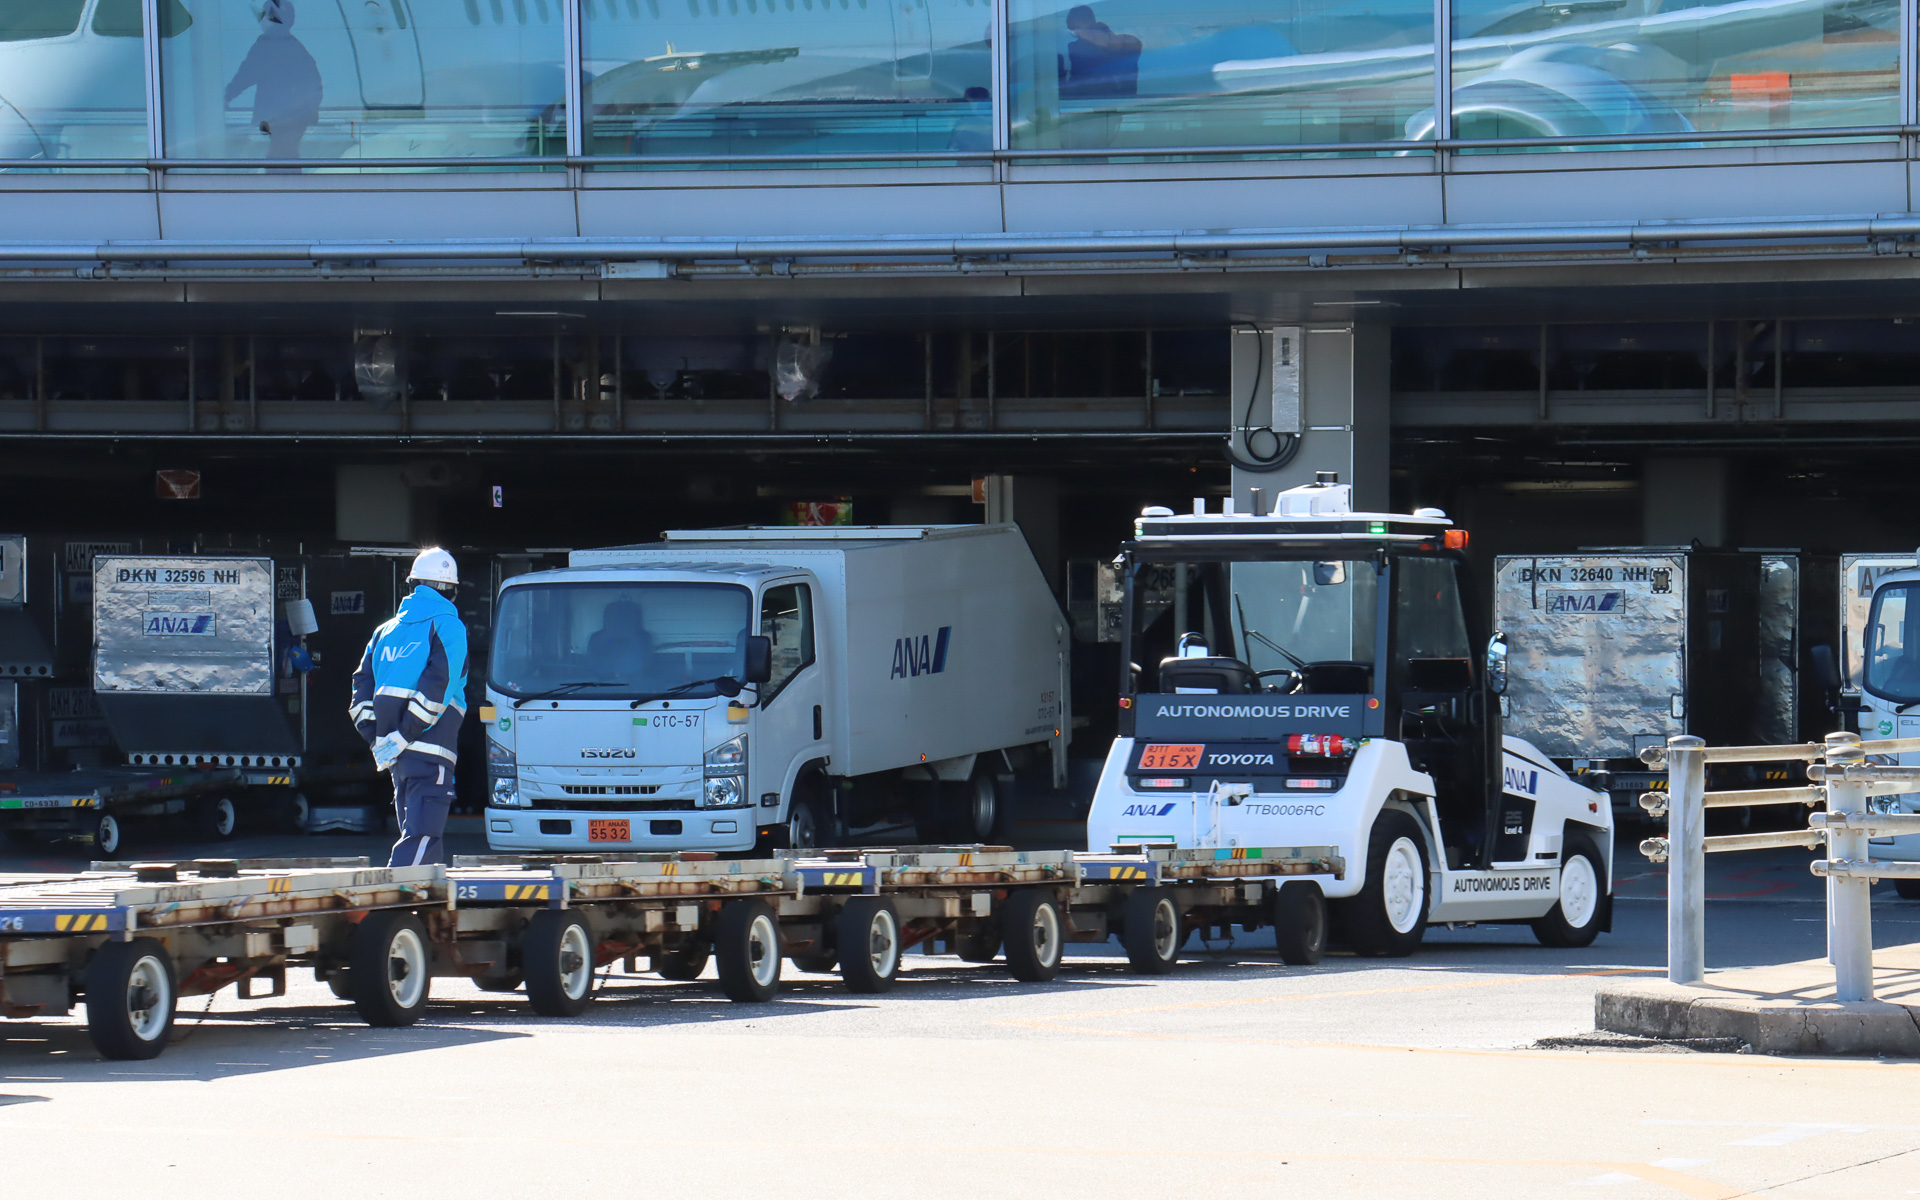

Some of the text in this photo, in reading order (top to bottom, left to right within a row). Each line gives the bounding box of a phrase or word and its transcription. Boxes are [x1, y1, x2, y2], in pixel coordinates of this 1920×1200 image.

[119, 568, 237, 583] DKN 32596 NH
[1521, 567, 1647, 582] DKN 32640 NH
[1550, 595, 1596, 611] ANA
[146, 616, 190, 633] ANA
[890, 634, 931, 680] ANA
[1155, 705, 1350, 718] AUTONOMOUS DRIVE
[652, 715, 700, 728] CTC-57
[580, 747, 636, 758] ISUZU
[1208, 753, 1274, 765] TOYOTA
[1143, 754, 1197, 768] 315X
[1503, 766, 1528, 793] ANA
[1121, 804, 1157, 817] ANA
[1245, 804, 1326, 817] TTB0006RC
[591, 827, 627, 840] 5532
[1453, 876, 1551, 893] AUTONOMOUS DRIVE
[458, 886, 478, 900] 25
